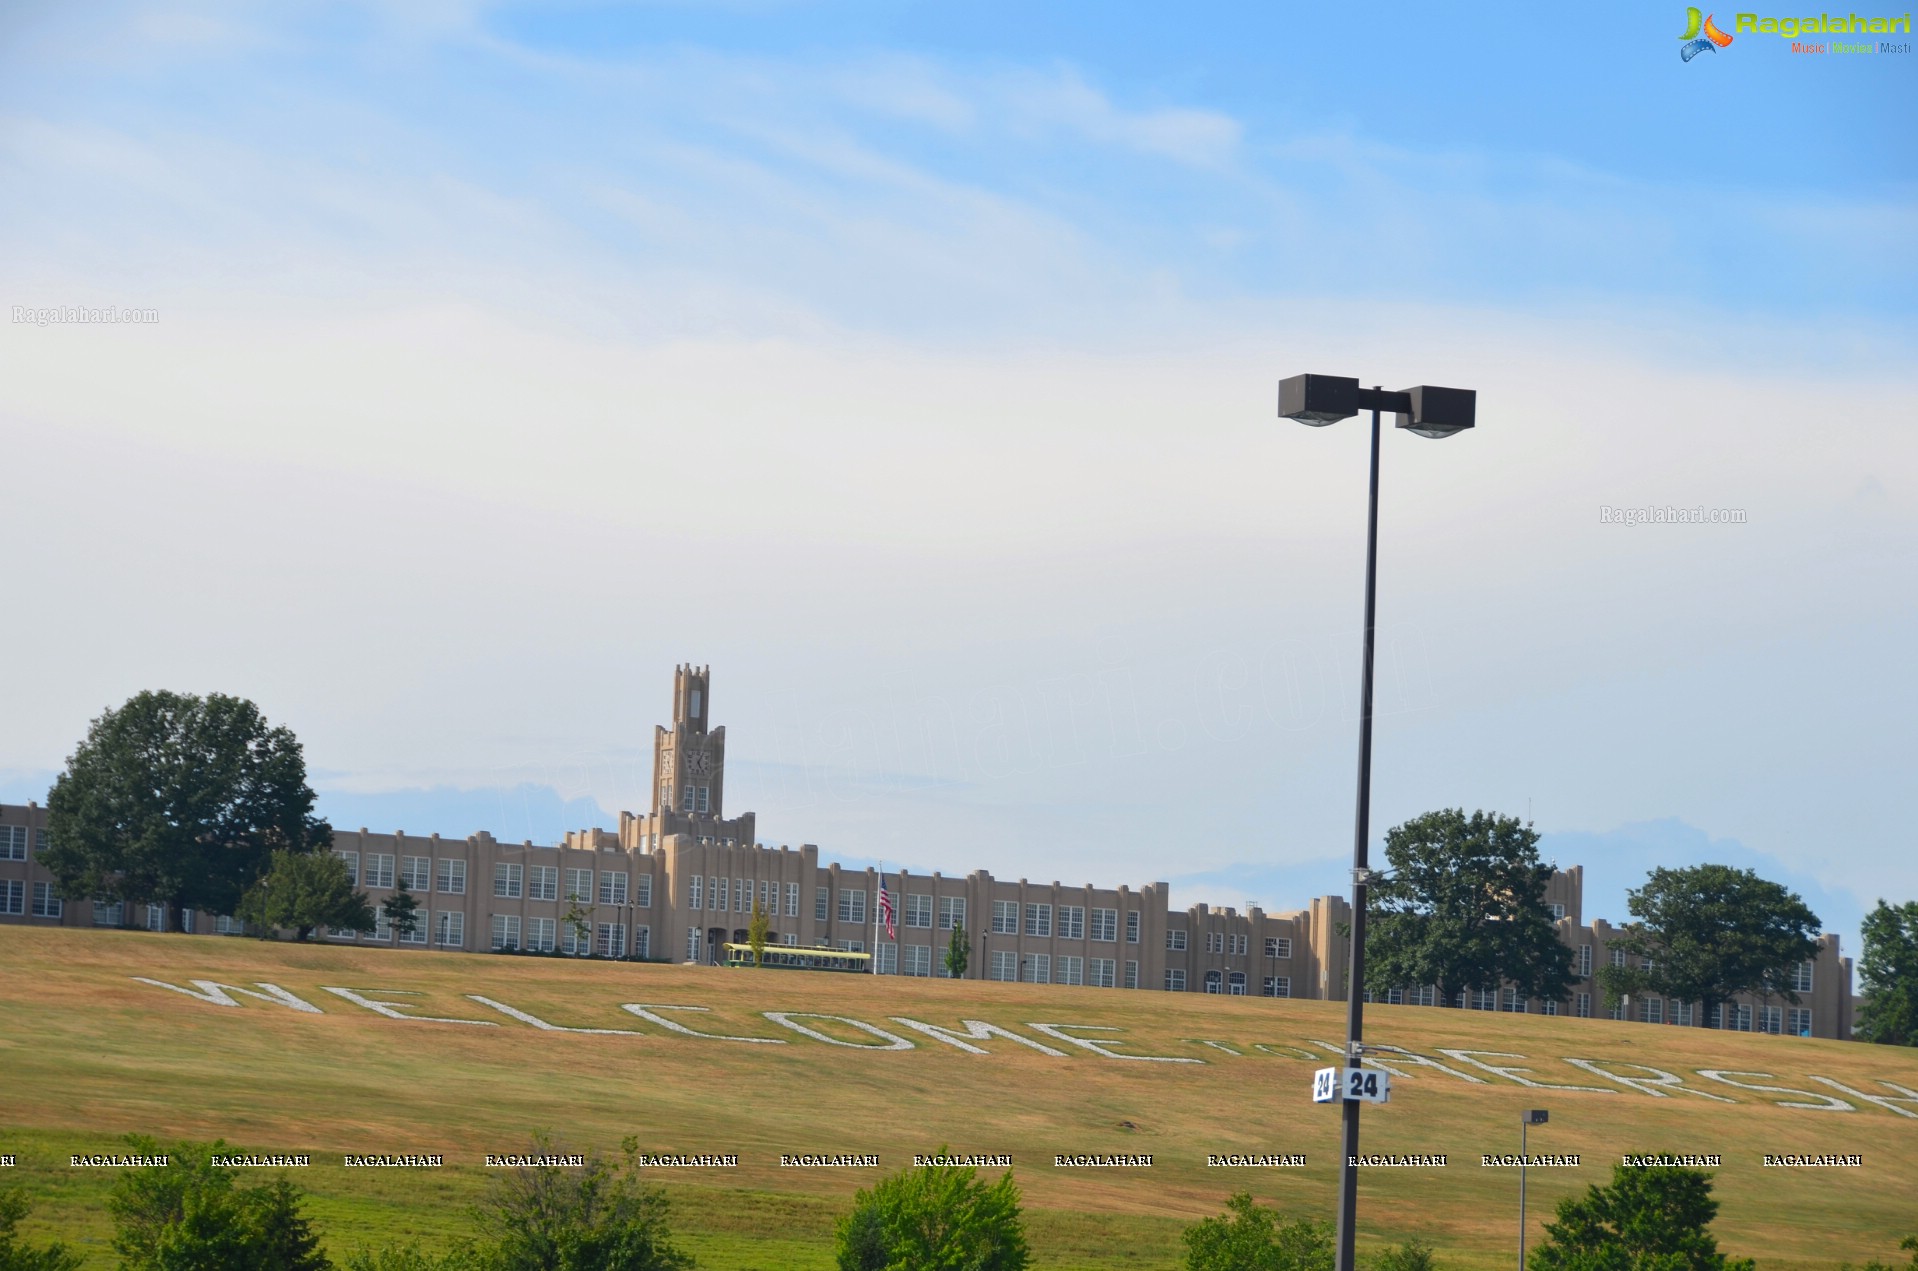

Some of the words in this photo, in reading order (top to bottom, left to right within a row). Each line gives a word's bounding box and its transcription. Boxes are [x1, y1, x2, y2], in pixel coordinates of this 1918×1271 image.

[131, 976, 1206, 1064] WELCOME
[1318, 1073, 1330, 1097] 24
[1351, 1072, 1378, 1097] 24
